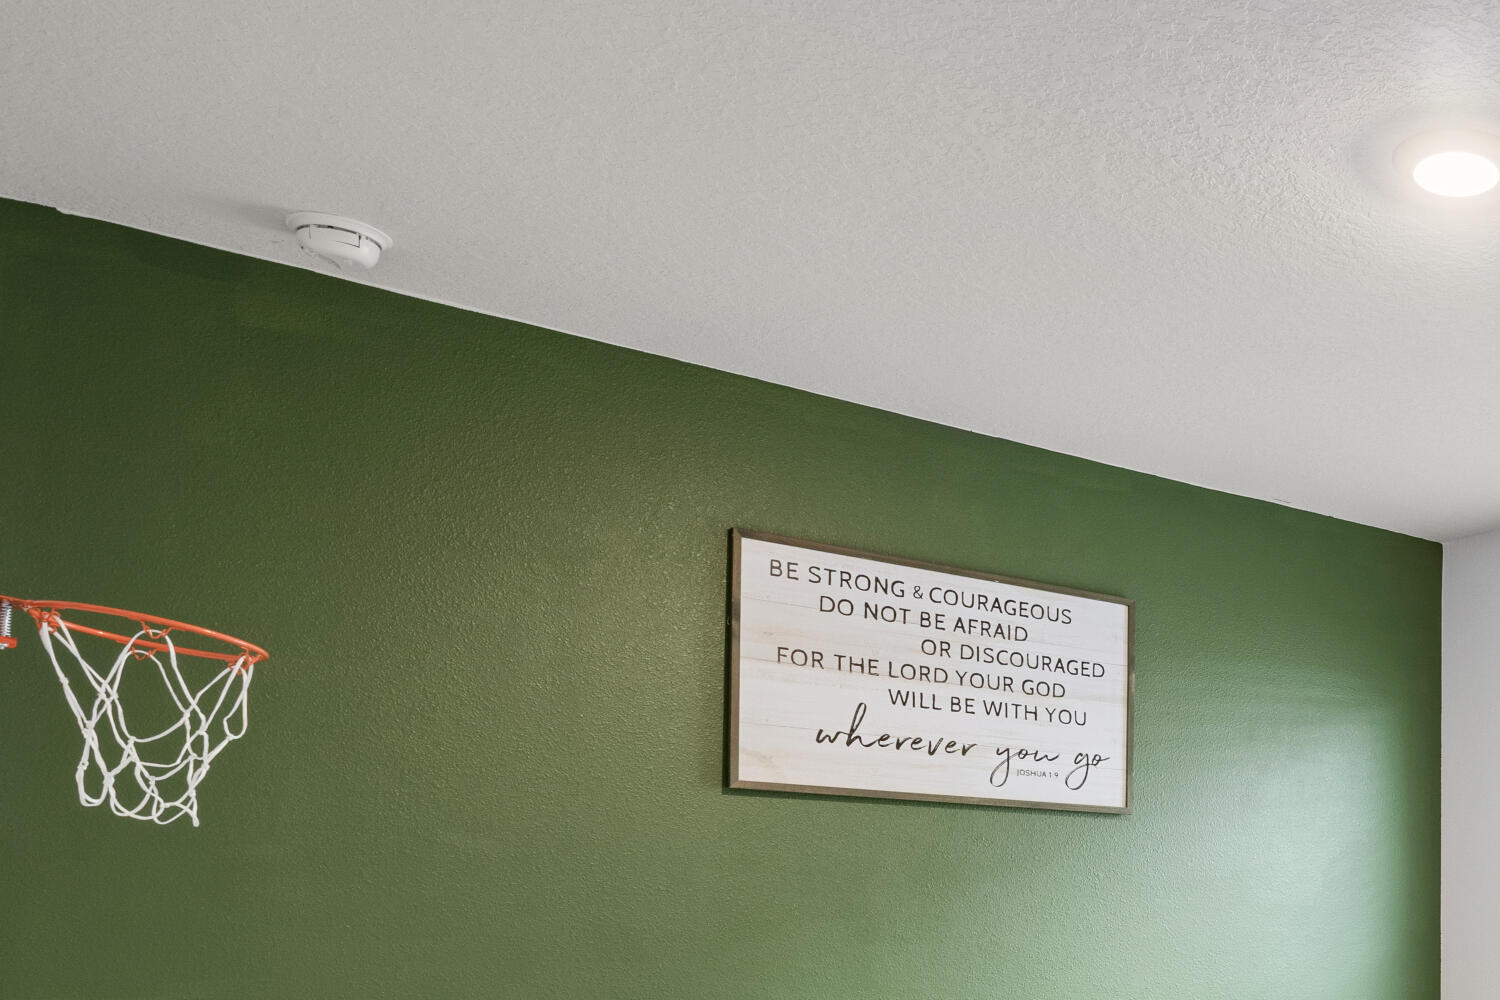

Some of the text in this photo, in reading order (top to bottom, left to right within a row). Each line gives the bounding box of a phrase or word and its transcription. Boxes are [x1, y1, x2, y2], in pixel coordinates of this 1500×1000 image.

[769, 558, 1072, 625] BE STRONG & COURAGEOUS
[819, 595, 1029, 642] DO NOT BE AFRAID
[777, 646, 1066, 698] FOR THE LORD YOUR GOD
[920, 638, 1106, 678] OR DISCOURAGED
[887, 688, 1087, 727] WILL BE WITH YOU
[815, 702, 1111, 791] wherever you go
[1016, 769, 1047, 778] JOSHUA
